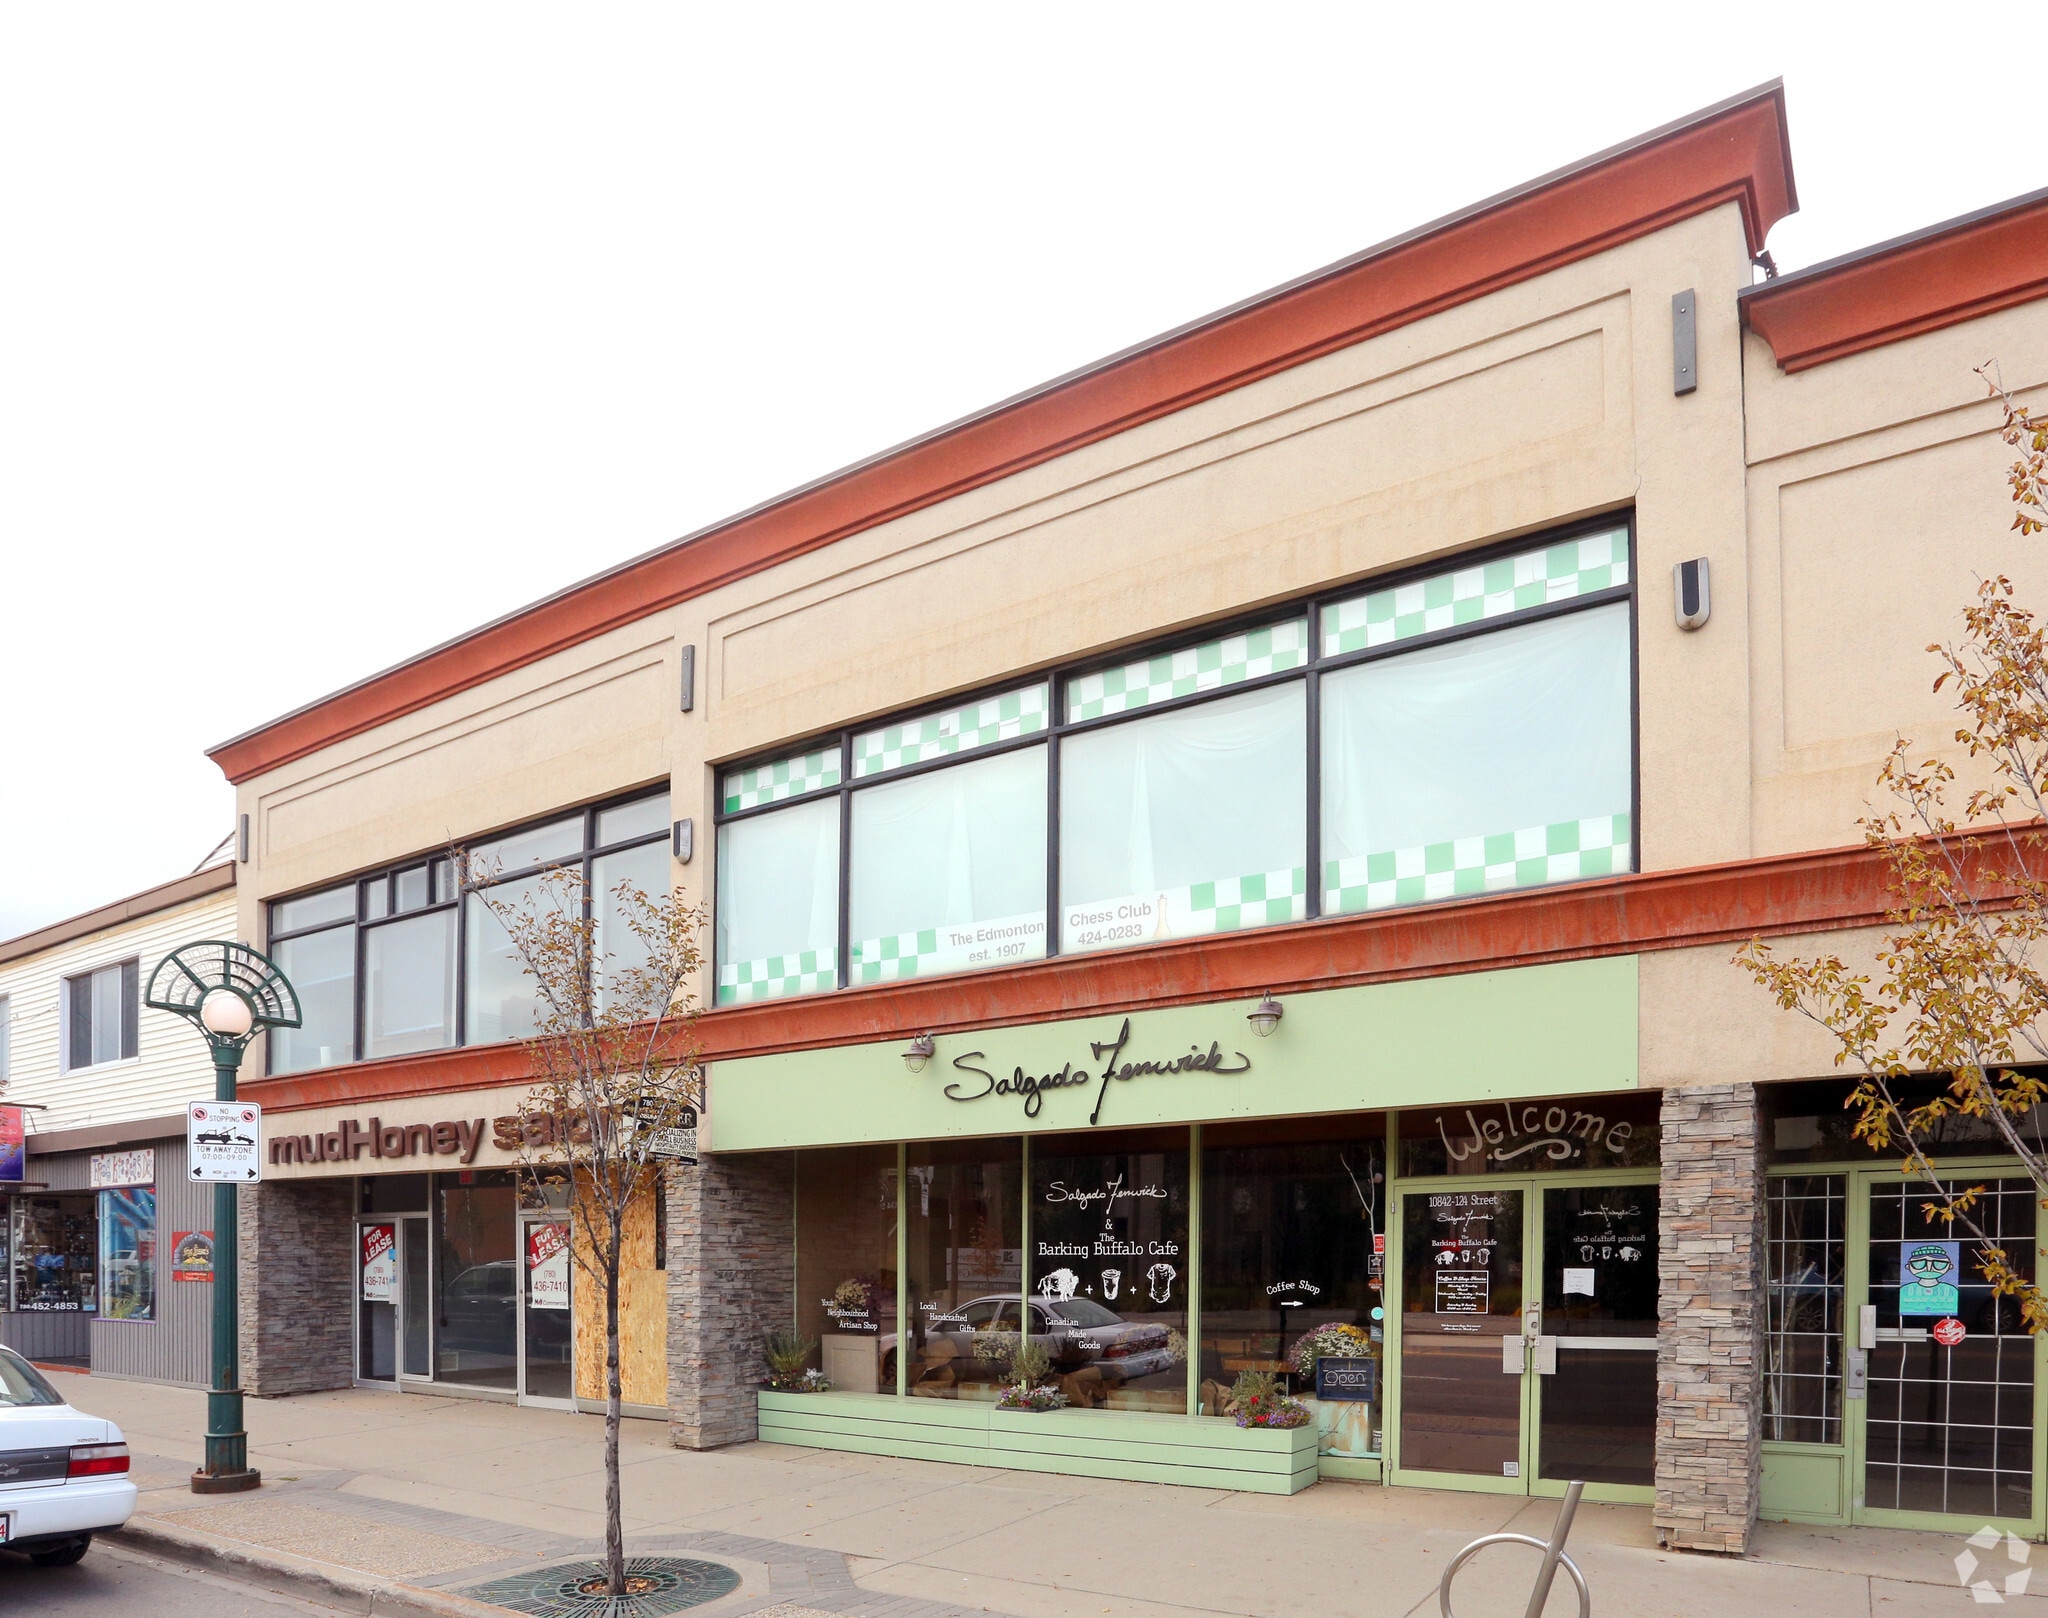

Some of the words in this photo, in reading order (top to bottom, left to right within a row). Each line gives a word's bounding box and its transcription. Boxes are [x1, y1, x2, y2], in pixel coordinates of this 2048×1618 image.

[1070, 910, 1114, 928] Chess
[1118, 902, 1152, 919] Club
[950, 932, 975, 947] The
[976, 921, 1045, 942] Edmonton
[1077, 924, 1143, 946] 424-0283
[968, 947, 991, 963] est.
[996, 942, 1026, 959] 1907
[944, 1051, 1090, 1118] Salgado
[1090, 1018, 1250, 1125] Fenwick
[209, 1115, 240, 1123] STOPPING
[1435, 1100, 1633, 1161] Welcome
[268, 1116, 486, 1165] mudHoney
[196, 1145, 212, 1153] TOW
[1046, 1181, 1106, 1210] Salgado
[1106, 1173, 1167, 1215] Fenwick
[1428, 1195, 1468, 1208] 10842-124
[1471, 1194, 1498, 1206] Street
[1105, 1218, 1113, 1230] &
[367, 1229, 382, 1247] FOR
[534, 1227, 554, 1247] FOR
[1099, 1233, 1115, 1242] The
[365, 1233, 393, 1262] LEASE
[532, 1231, 567, 1265] LEASE
[1038, 1241, 1089, 1259] Barking
[1093, 1241, 1144, 1256] Buffalo
[1148, 1241, 1179, 1256] Cafe
[1431, 1240, 1456, 1248] Barking
[543, 1269, 556, 1279] (780)
[364, 1276, 389, 1286] 436-741
[534, 1280, 568, 1292] 436-7410
[1266, 1281, 1295, 1295] Coffee
[1298, 1279, 1321, 1296] Shop
[31, 1302, 79, 1310] 452-4853
[821, 1298, 834, 1307] Your
[919, 1302, 937, 1310] Local
[827, 1309, 869, 1318] Neighbourhood
[929, 1312, 968, 1322] Handcrafted
[838, 1320, 862, 1329] Artisan
[863, 1321, 878, 1331] Shop
[1045, 1317, 1079, 1326] Canadian
[959, 1324, 976, 1333] Gifts
[1068, 1329, 1087, 1338] Made
[1078, 1340, 1101, 1349] Goods
[1325, 1370, 1365, 1385] Open
